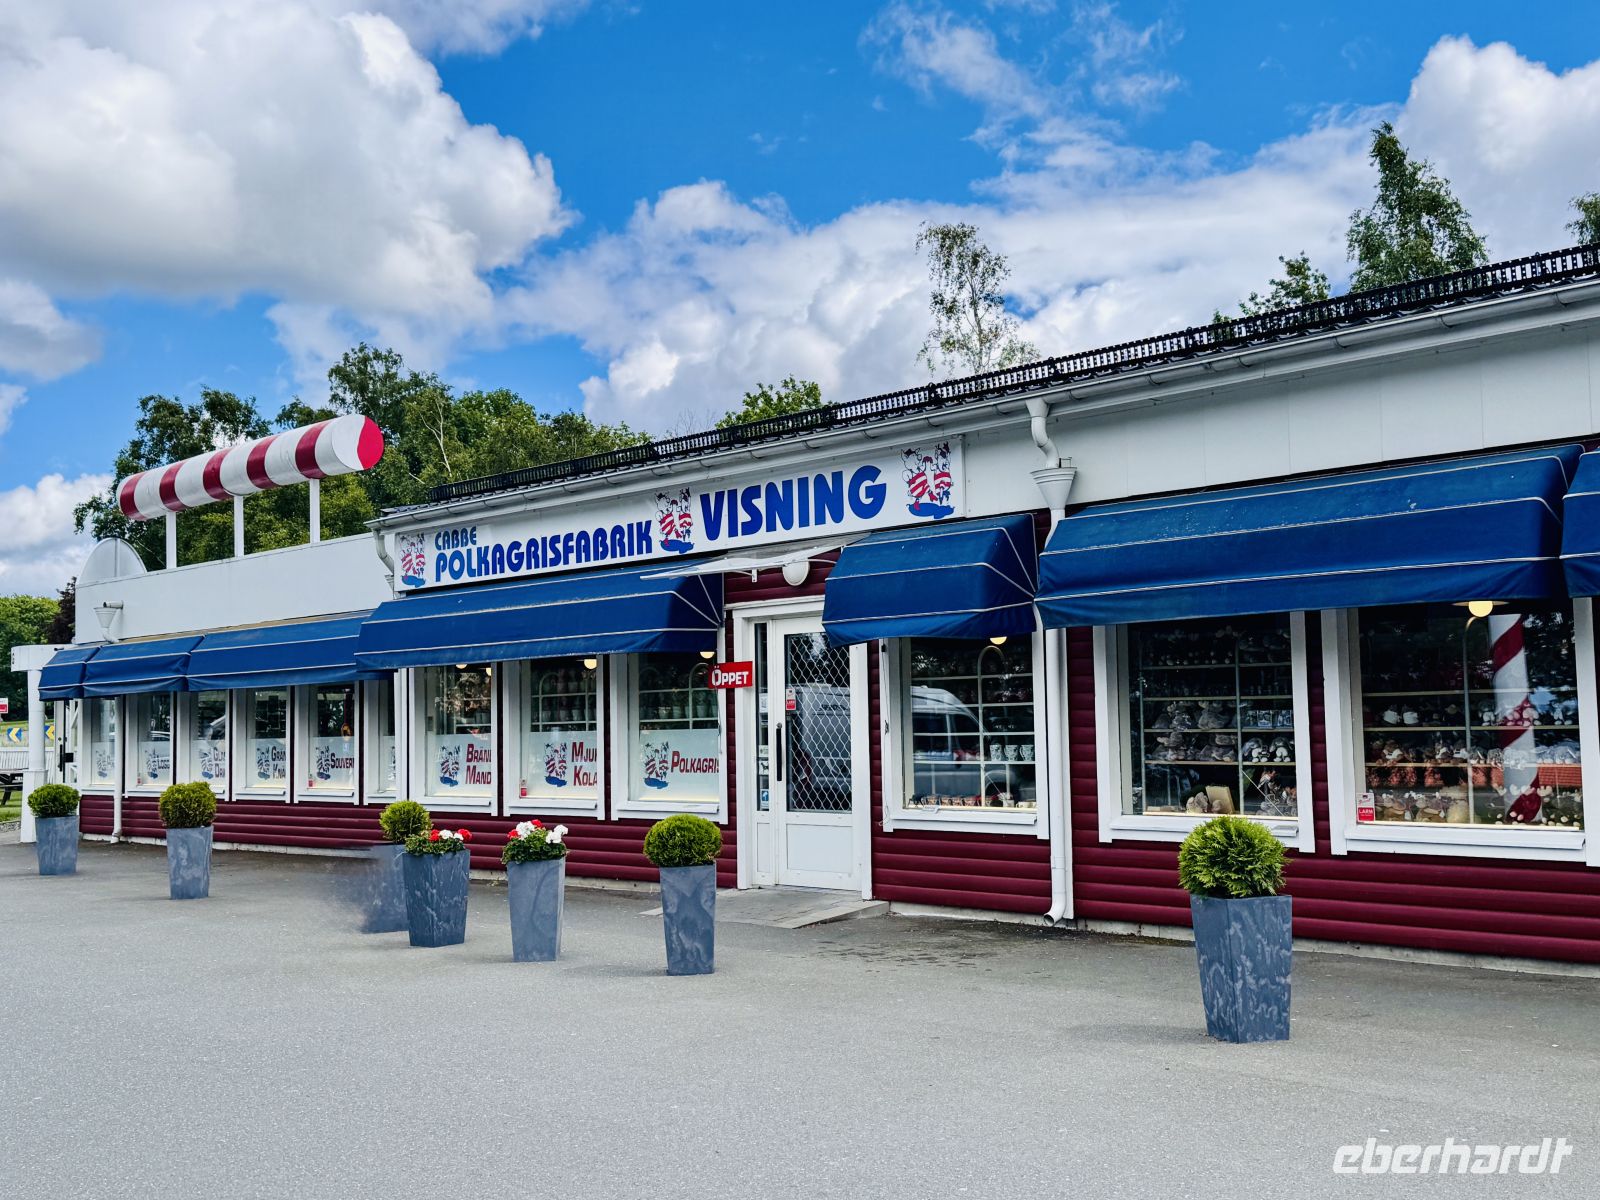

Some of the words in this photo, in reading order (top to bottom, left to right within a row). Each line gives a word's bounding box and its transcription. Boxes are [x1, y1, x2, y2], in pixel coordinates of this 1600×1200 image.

[700, 465, 887, 541] VISNING
[434, 526, 477, 551] CABBE
[435, 520, 653, 583] POLKAGRISFABRIK
[711, 665, 750, 687] ÖPPET
